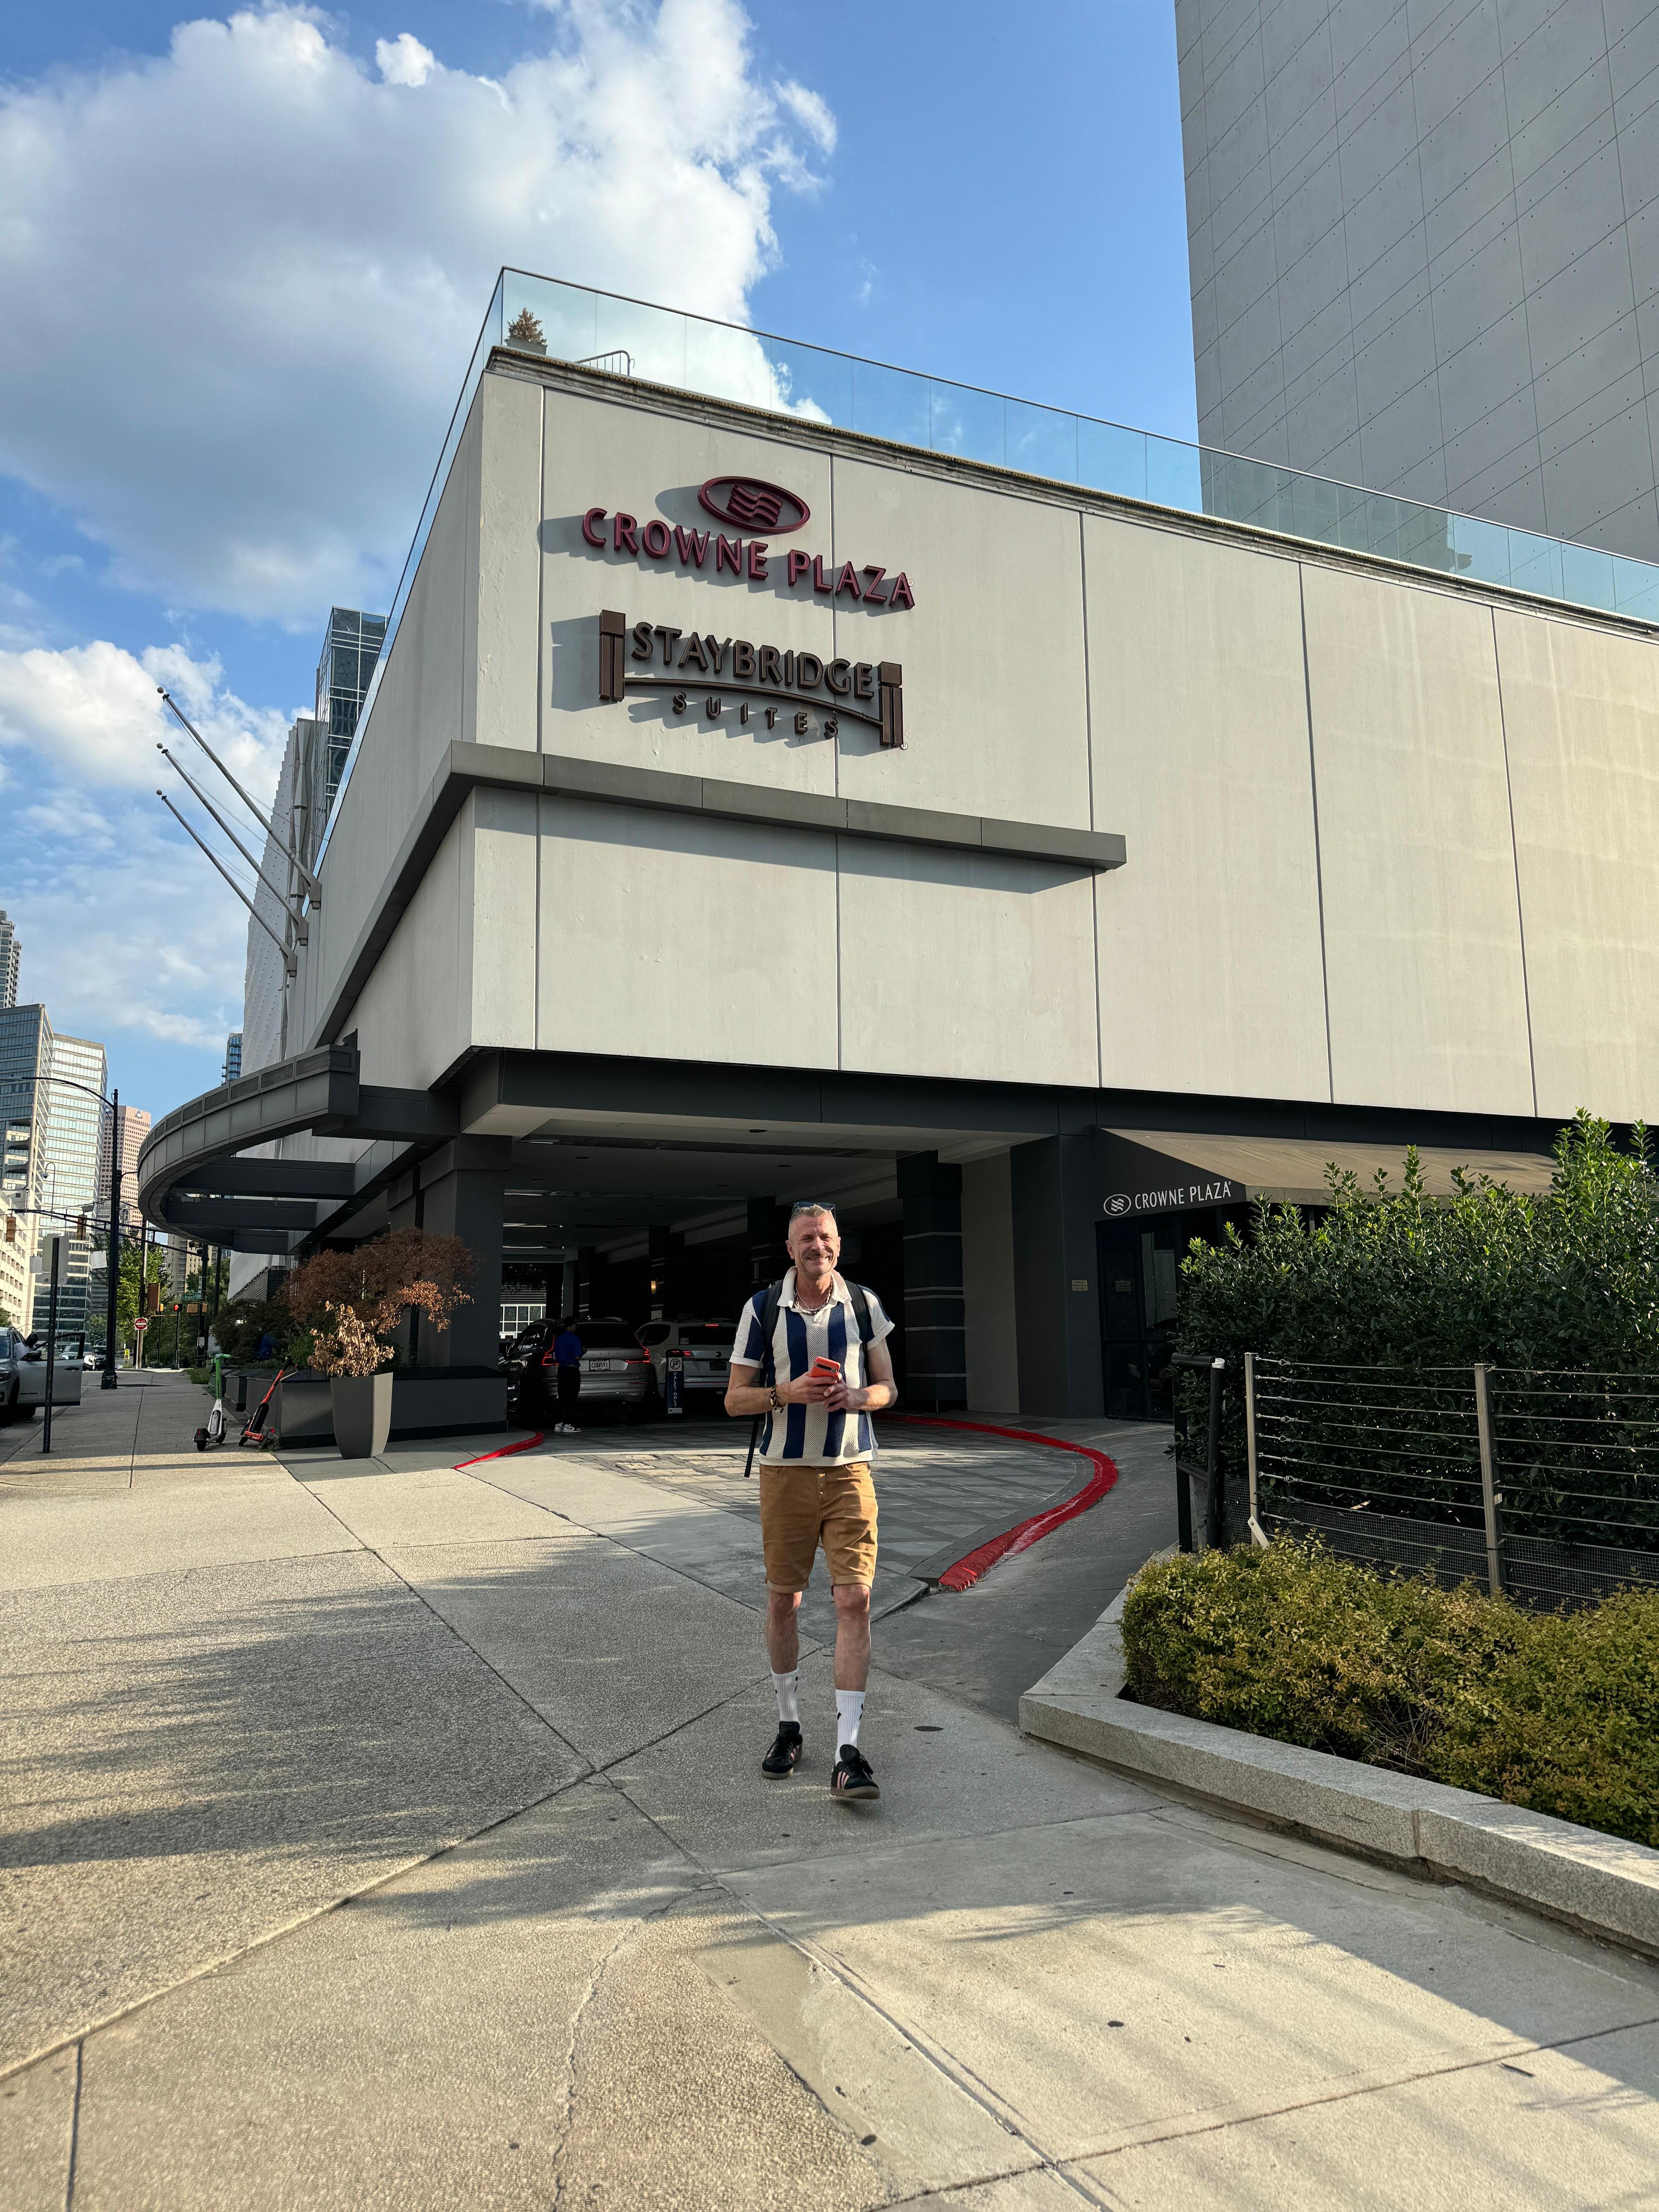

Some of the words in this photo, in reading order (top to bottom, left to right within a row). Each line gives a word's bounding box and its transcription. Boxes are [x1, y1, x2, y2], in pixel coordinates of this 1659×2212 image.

[582, 508, 768, 580] CROWNE
[788, 549, 915, 609] PLAZA
[632, 622, 874, 700] STAYBRIDGE
[673, 692, 838, 739] SUITES
[1135, 1188, 1185, 1209] CROWNE
[1190, 1181, 1231, 1202] PLAZA
